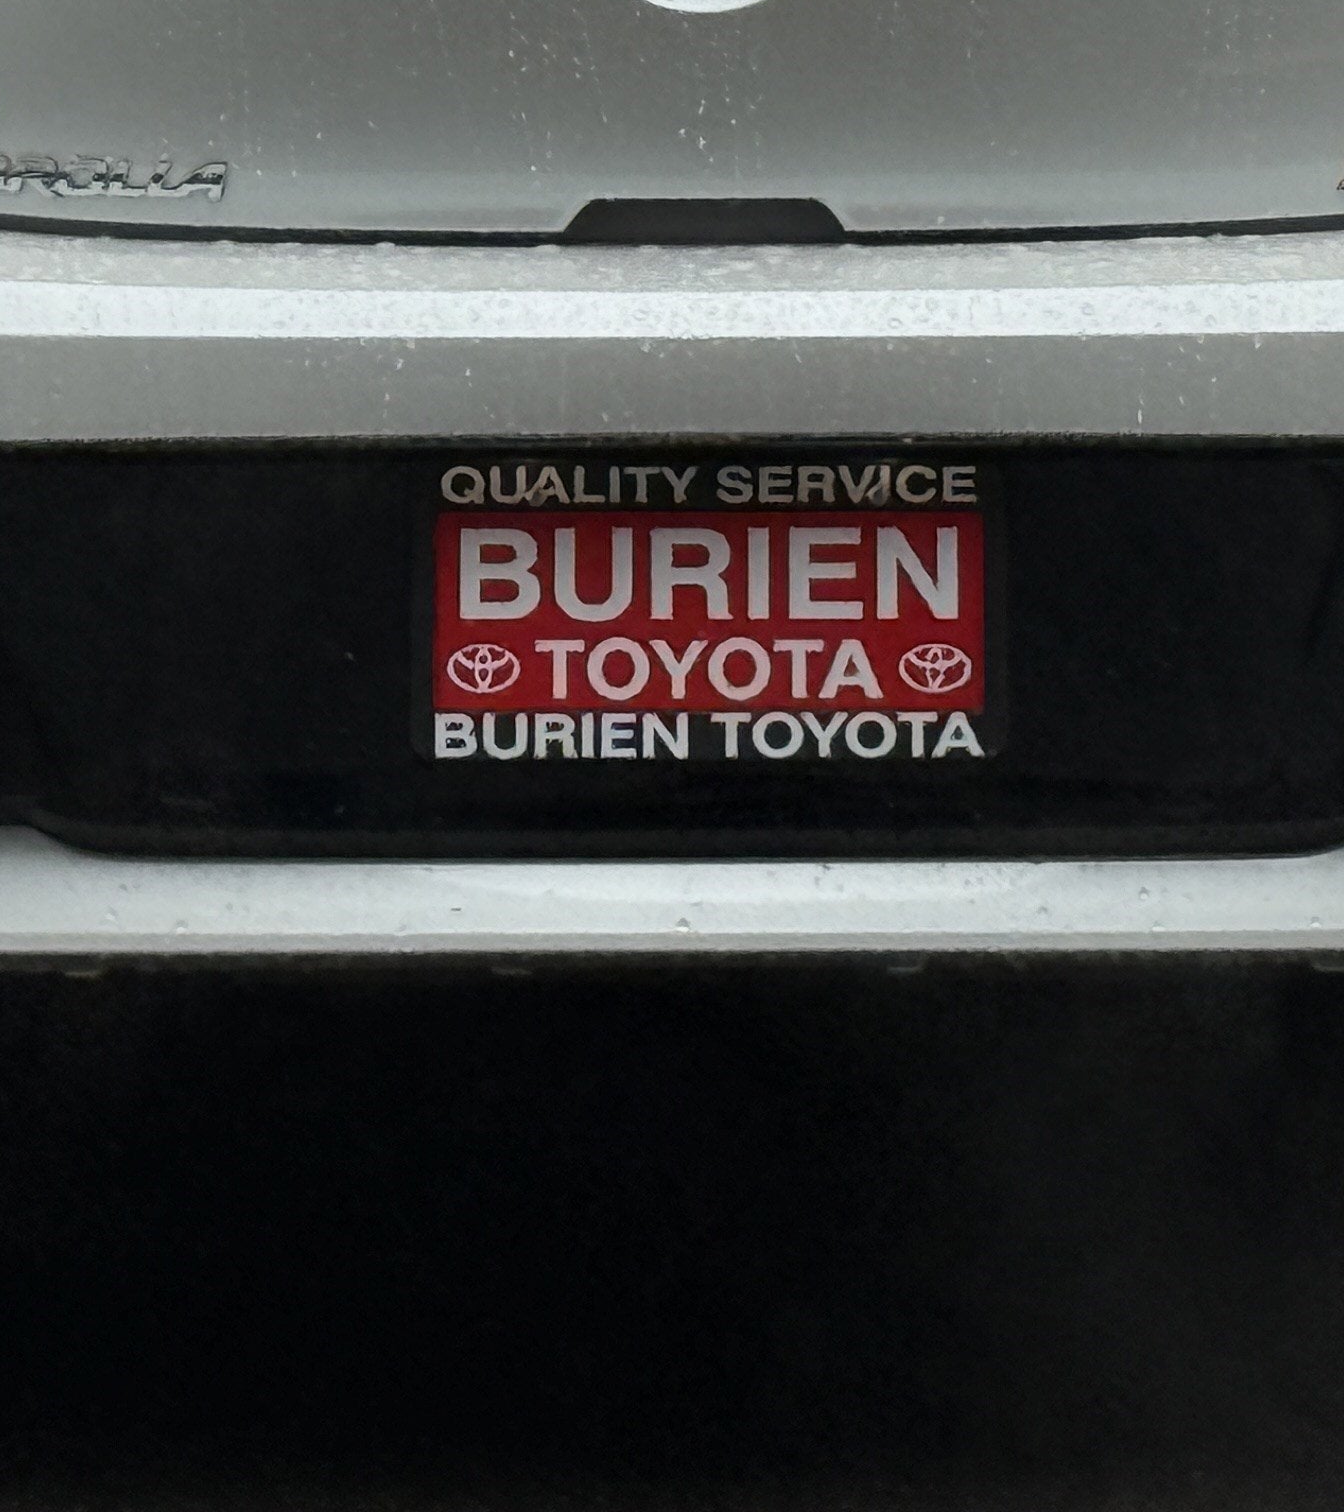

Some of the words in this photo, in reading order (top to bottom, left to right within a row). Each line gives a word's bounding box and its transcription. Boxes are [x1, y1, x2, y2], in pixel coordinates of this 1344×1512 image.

[439, 464, 698, 505] QUALITY
[715, 464, 977, 505] SERVICE
[458, 525, 960, 622] BURIEN
[534, 636, 885, 701] TOYOTA
[433, 711, 690, 760] BURIEN
[710, 711, 986, 760] TOYOTA
